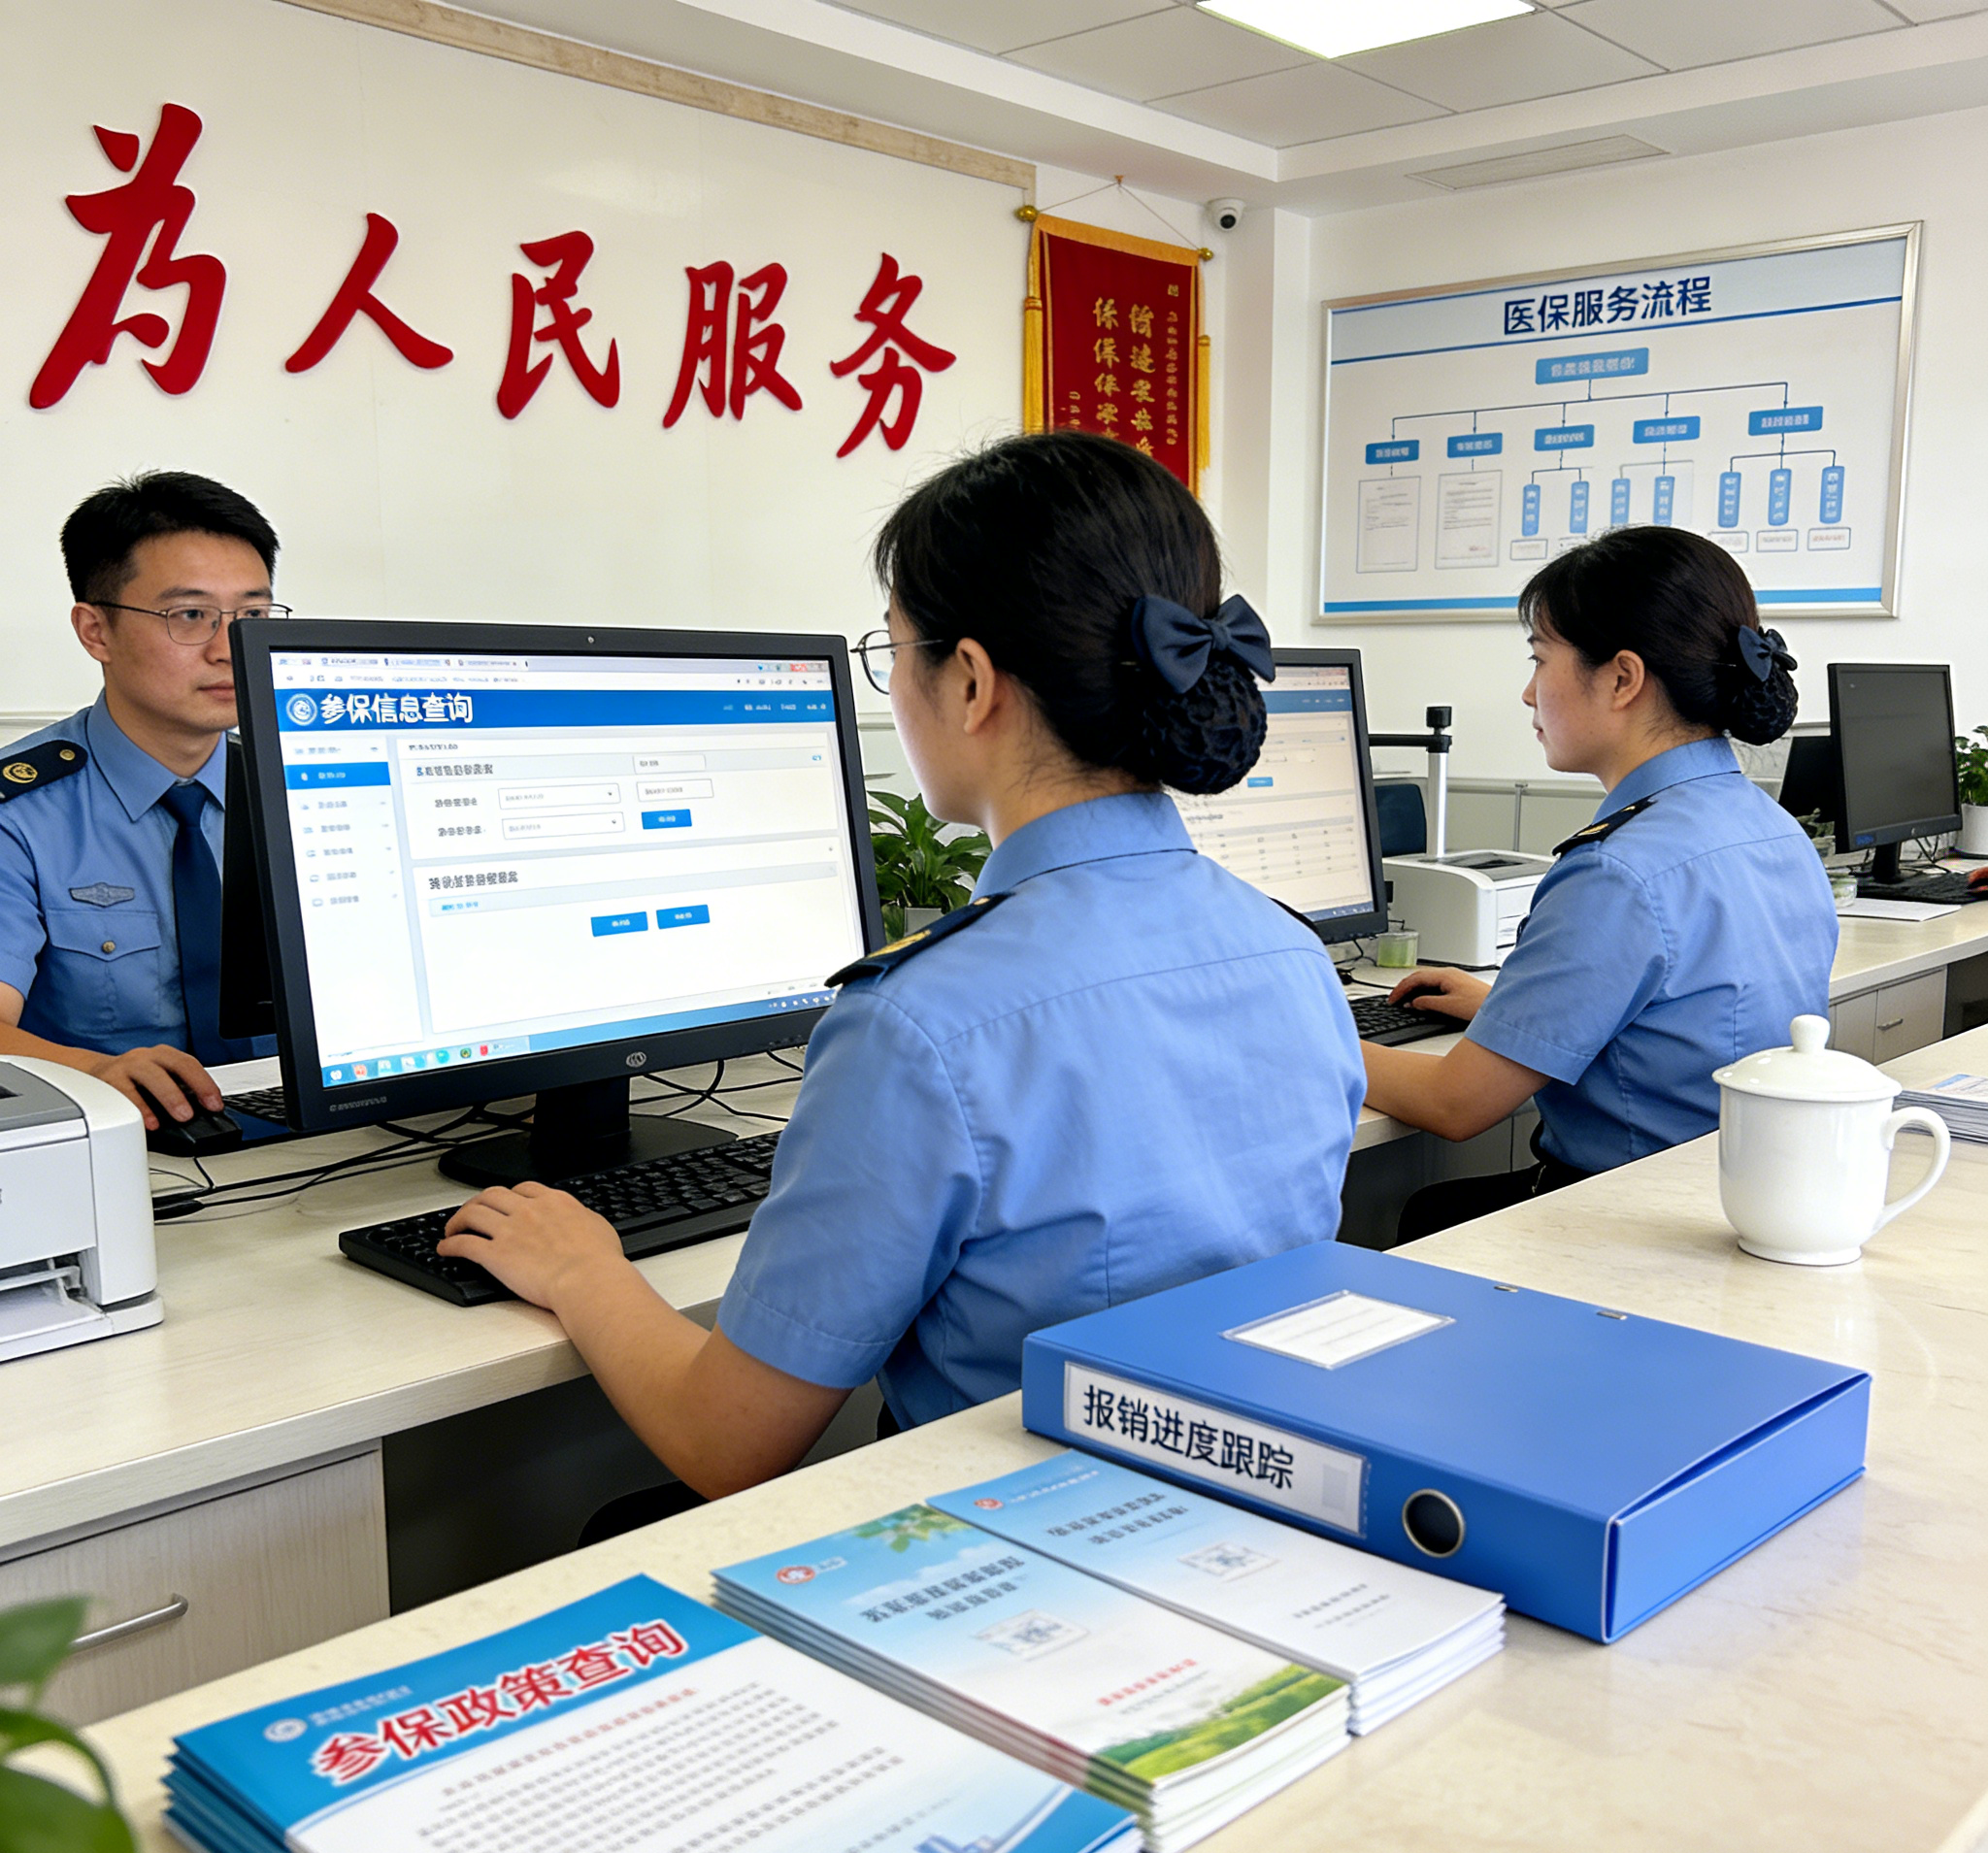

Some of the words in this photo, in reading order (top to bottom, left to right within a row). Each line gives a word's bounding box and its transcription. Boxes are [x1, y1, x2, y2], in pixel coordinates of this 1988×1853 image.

[29, 102, 957, 459] 为人民服务
[1504, 276, 1711, 335] 医保服务流程
[320, 692, 474, 724] 参保信息查询
[1082, 1384, 1294, 1490] 报销进度跟踪
[312, 1618, 690, 1786] 参保政策查询
